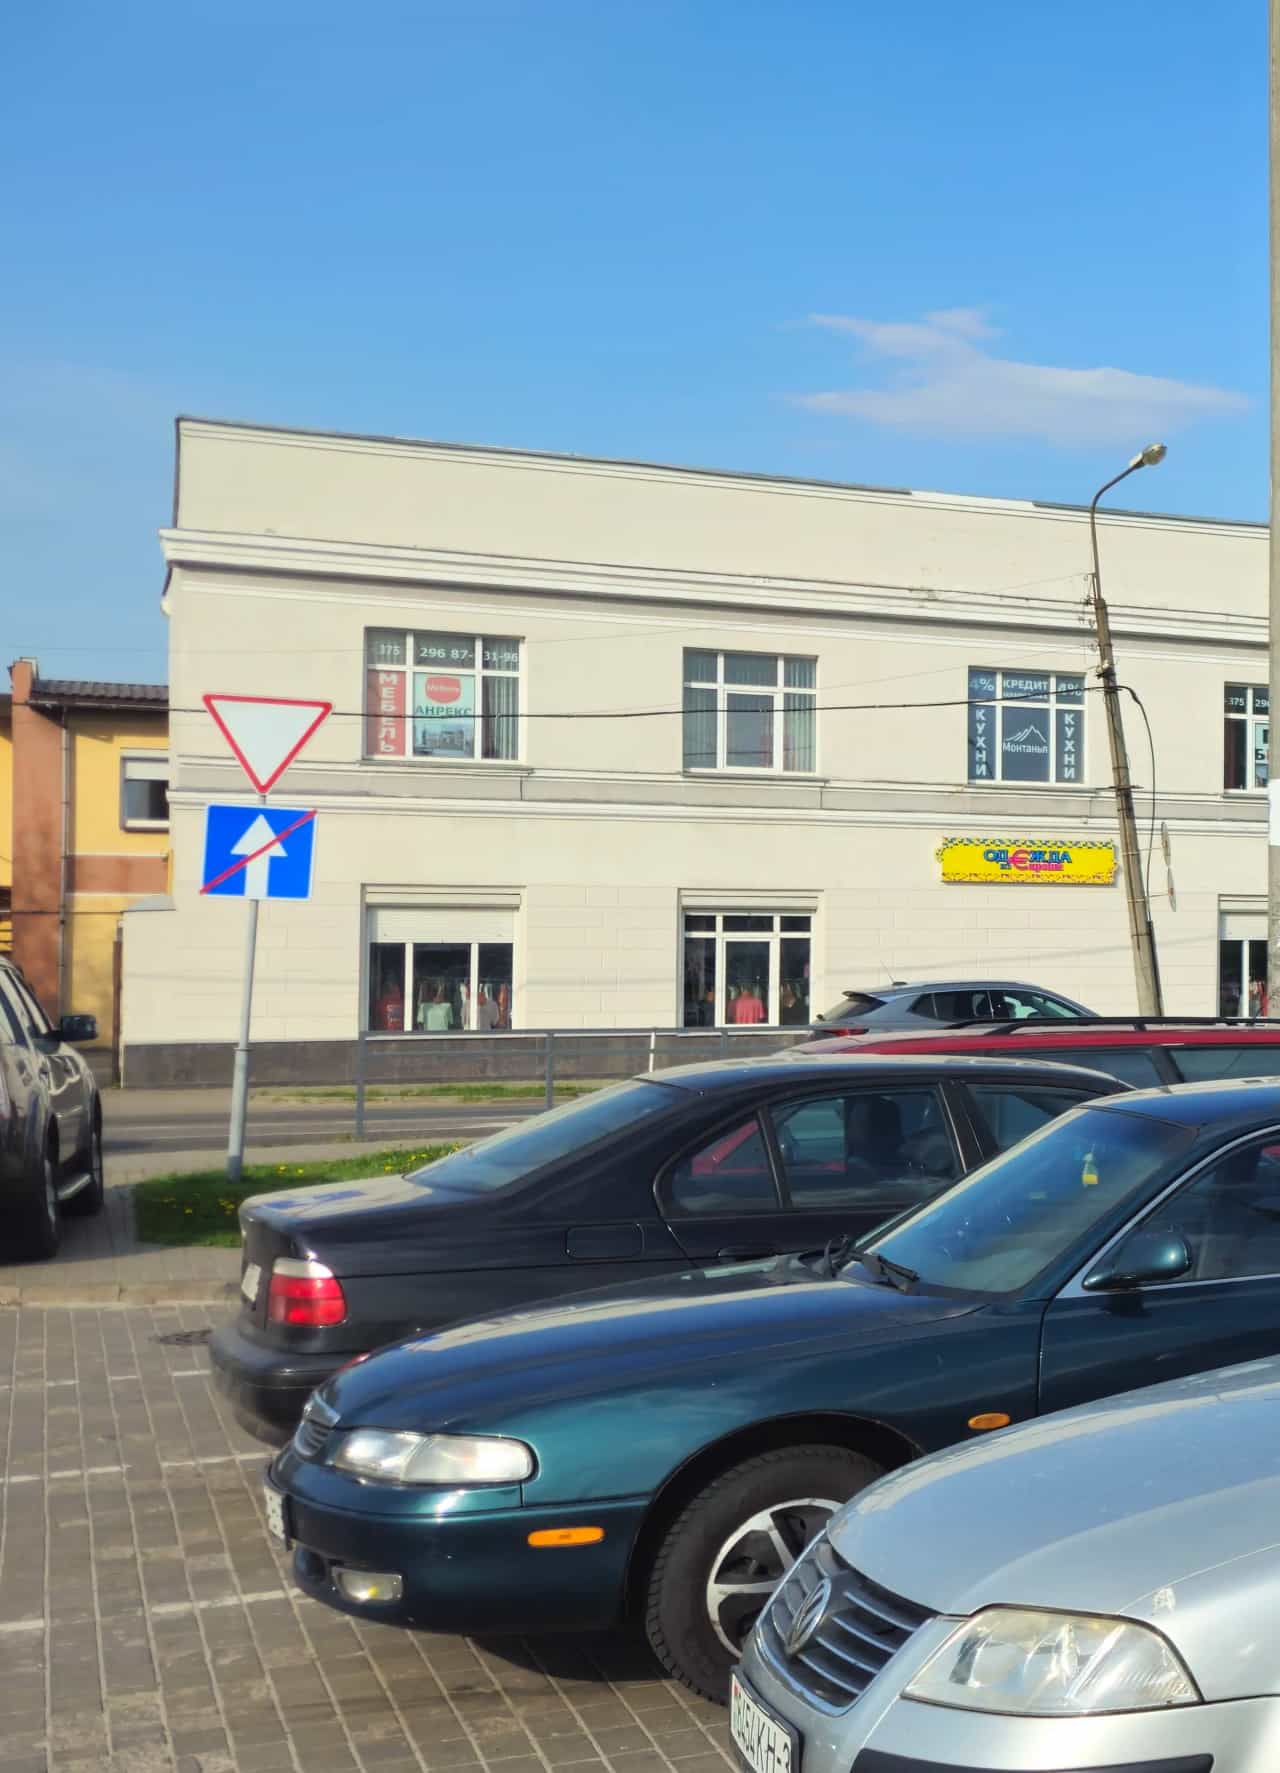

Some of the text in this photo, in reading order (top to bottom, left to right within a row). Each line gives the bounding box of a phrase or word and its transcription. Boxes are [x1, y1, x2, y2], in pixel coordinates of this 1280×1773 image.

[419, 647, 446, 658] 296
[1003, 679, 1049, 691] КРЕДИТ
[378, 672, 398, 753] МЕБЕЛЬ
[975, 708, 987, 777] КУХНИ
[1063, 713, 1075, 779] КУХНИ
